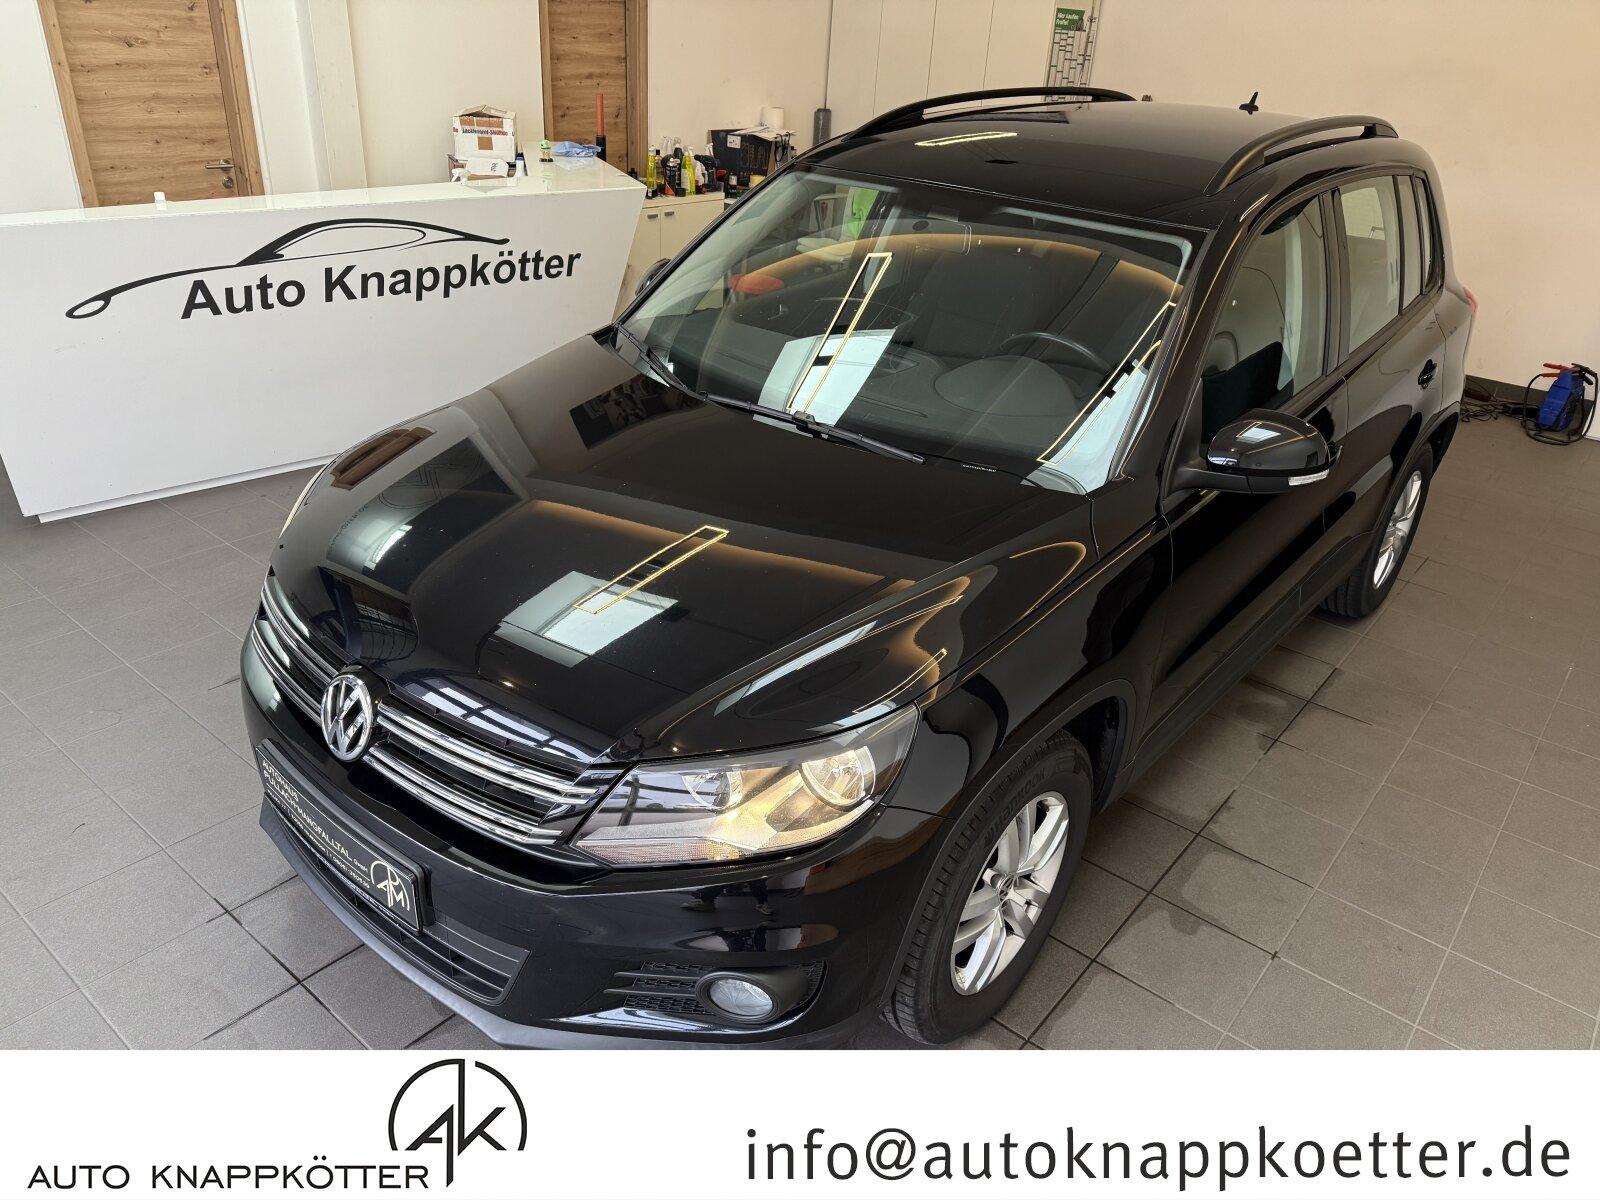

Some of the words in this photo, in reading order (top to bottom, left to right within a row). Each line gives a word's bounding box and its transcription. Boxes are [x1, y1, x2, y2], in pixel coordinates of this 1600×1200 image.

[181, 274, 306, 320] Auto
[324, 249, 582, 303] Knappkötter
[262, 759, 299, 802] AUTOHAUS
